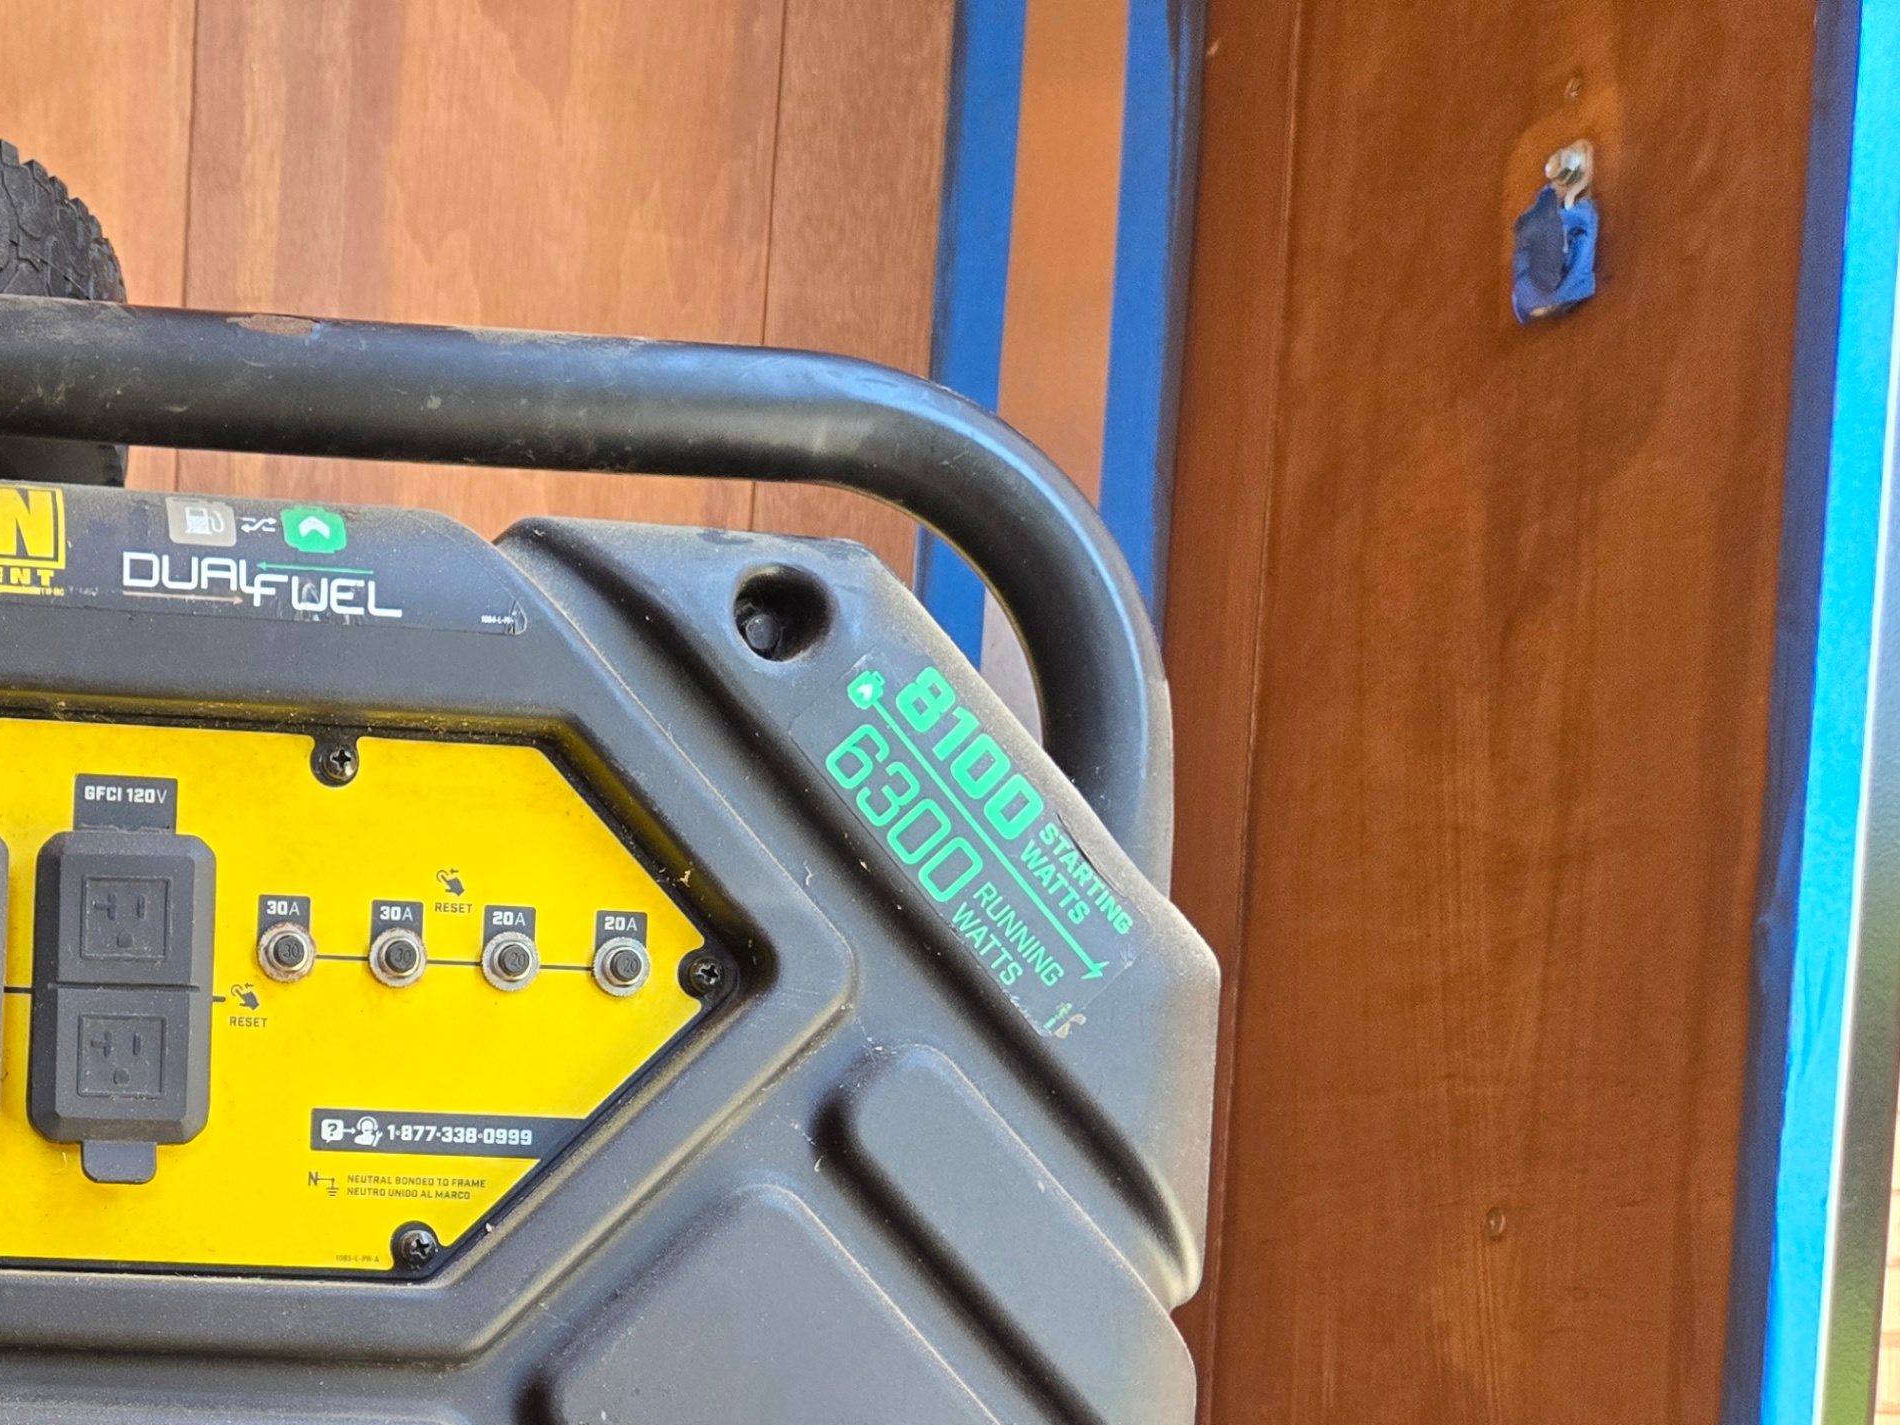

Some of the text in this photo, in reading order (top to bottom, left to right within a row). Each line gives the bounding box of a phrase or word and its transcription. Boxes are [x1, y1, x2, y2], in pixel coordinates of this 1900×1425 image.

[84, 785, 168, 805] GFCI 120V
[895, 666, 1134, 935] 8100 STARTING
[825, 723, 1065, 987] 6300 RUNNING
[1020, 839, 1090, 925] WATTS
[266, 899, 300, 917] 30A
[380, 905, 413, 922] 30A
[435, 902, 473, 914] RESET
[492, 911, 526, 928] 20A
[604, 916, 638, 932] 20A
[951, 901, 1023, 987] WATTS
[229, 1016, 268, 1028] RESET
[308, 1171, 486, 1188] N NEUTRAL BONDED TO FRAME
[347, 1187, 470, 1200] NEUTRO UNIDO AL MARCO
